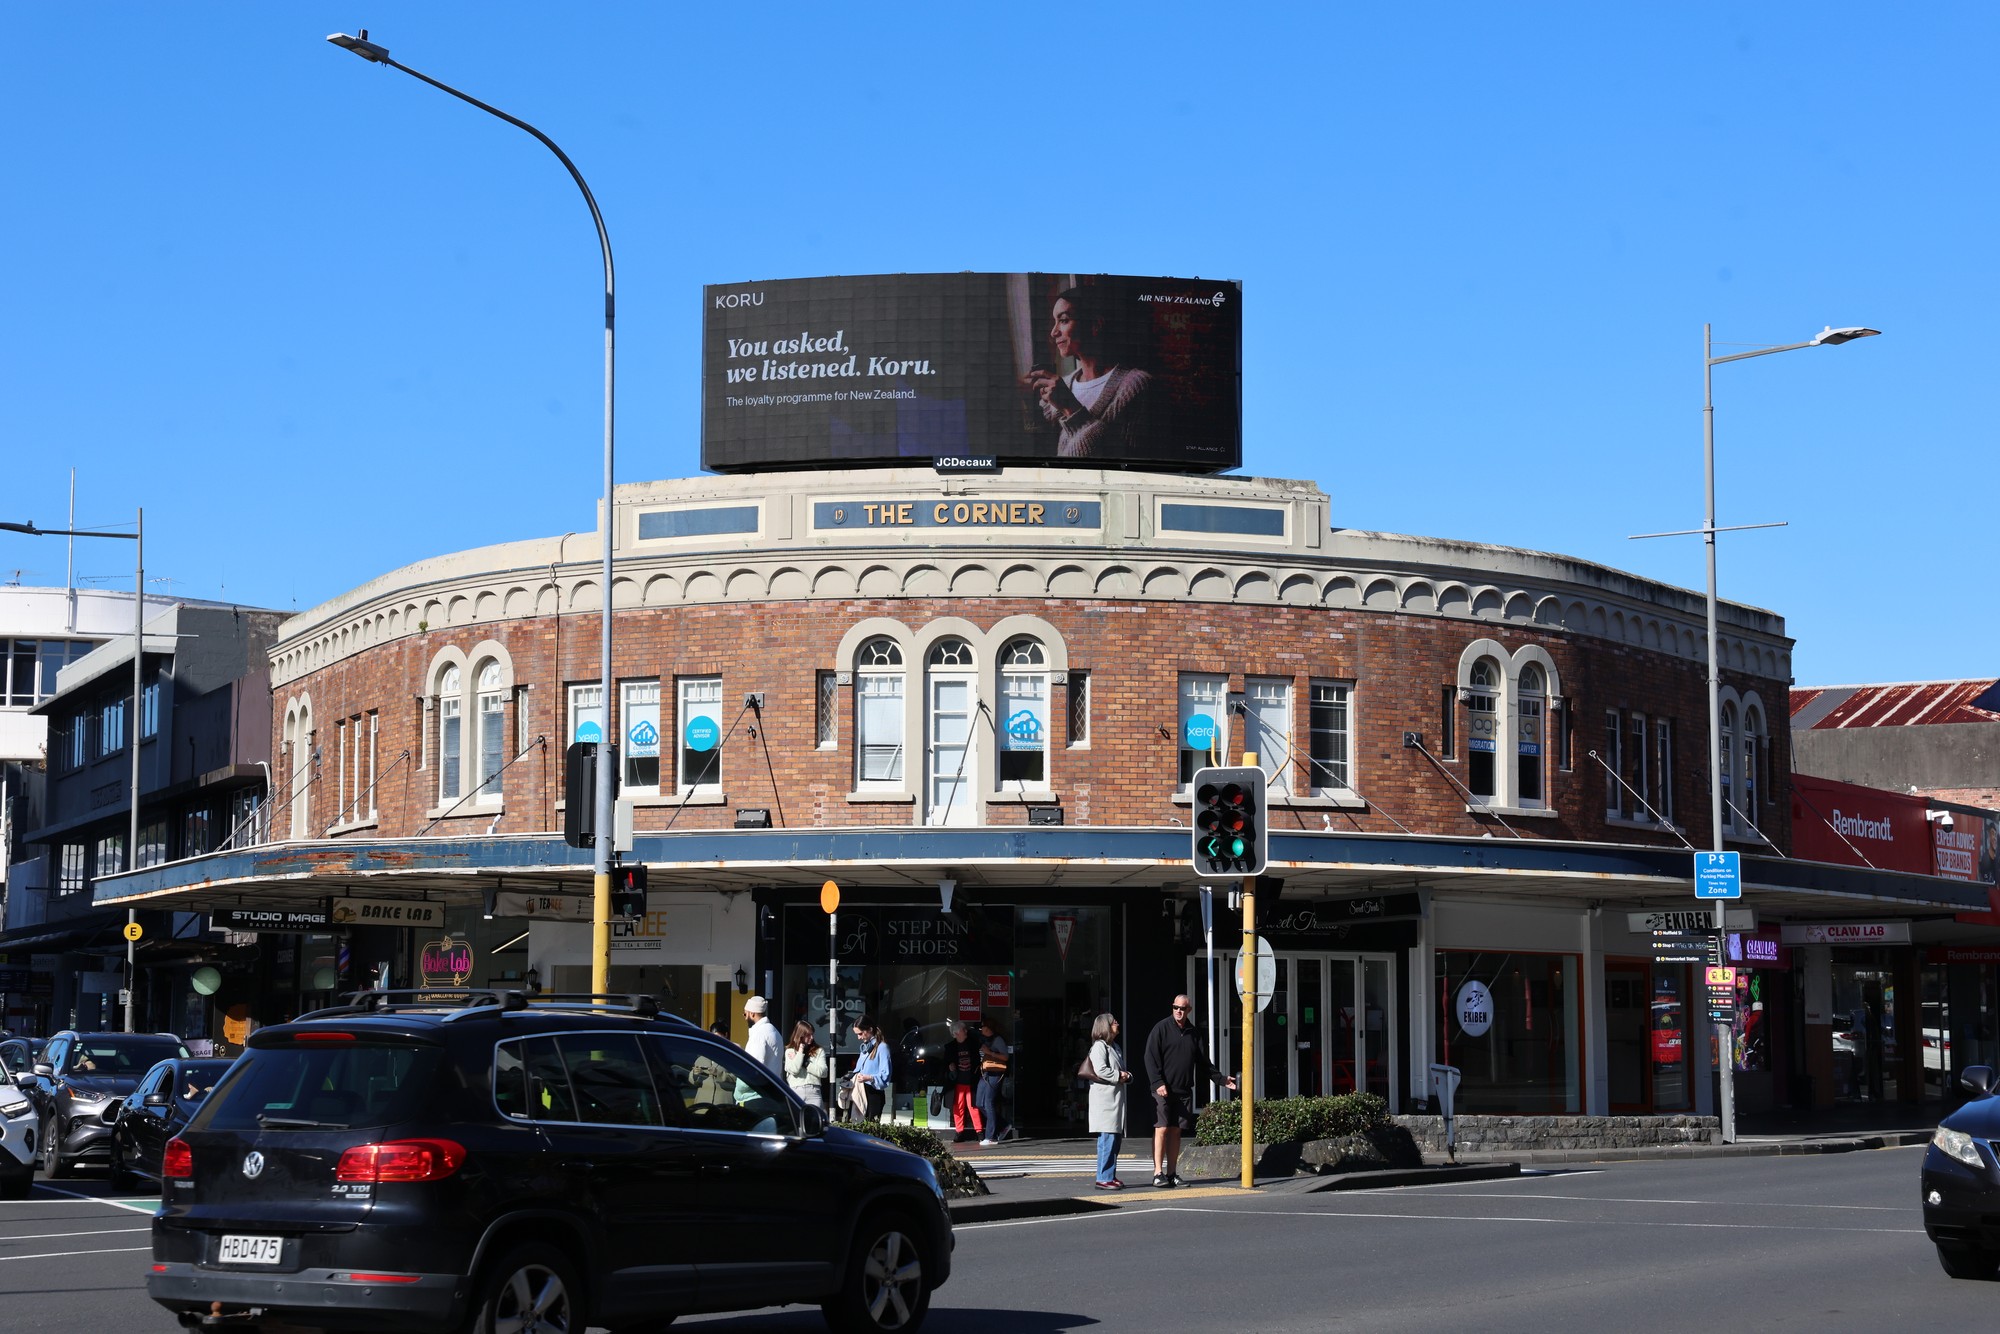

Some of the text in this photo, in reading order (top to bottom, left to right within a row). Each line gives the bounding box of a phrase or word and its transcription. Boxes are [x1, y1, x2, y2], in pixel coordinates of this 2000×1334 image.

[715, 292, 764, 309] KORU
[1138, 294, 1211, 306] AIR NEW ZEALAND
[727, 330, 850, 359] You asked,
[726, 355, 936, 384] we listened. Koru.
[727, 388, 916, 408] The loyalty programme for New Zealand.
[936, 457, 992, 468] JCDecaux
[834, 503, 1079, 525] 19 THE CORNER 29
[1936, 829, 1975, 850] EXPERT ADVICE
[1708, 854, 1717, 865] P
[1949, 852, 1971, 871] BRANDS
[1708, 886, 1727, 894] Zone
[232, 911, 326, 923] STUDIO IMAGE
[361, 904, 433, 921] BAKE LAB
[1664, 912, 1713, 929] EKIBEN
[130, 927, 137, 937] E
[888, 920, 969, 935] STEP INN
[1828, 926, 1885, 937] CLAW LAB
[898, 939, 958, 955] SHOES
[424, 949, 470, 973] Bake Lab
[811, 994, 862, 1011] Gabor
[1463, 1011, 1487, 1023] EKIBEN
[351, 1184, 371, 1193] TDI
[221, 1237, 279, 1260] HBD475
